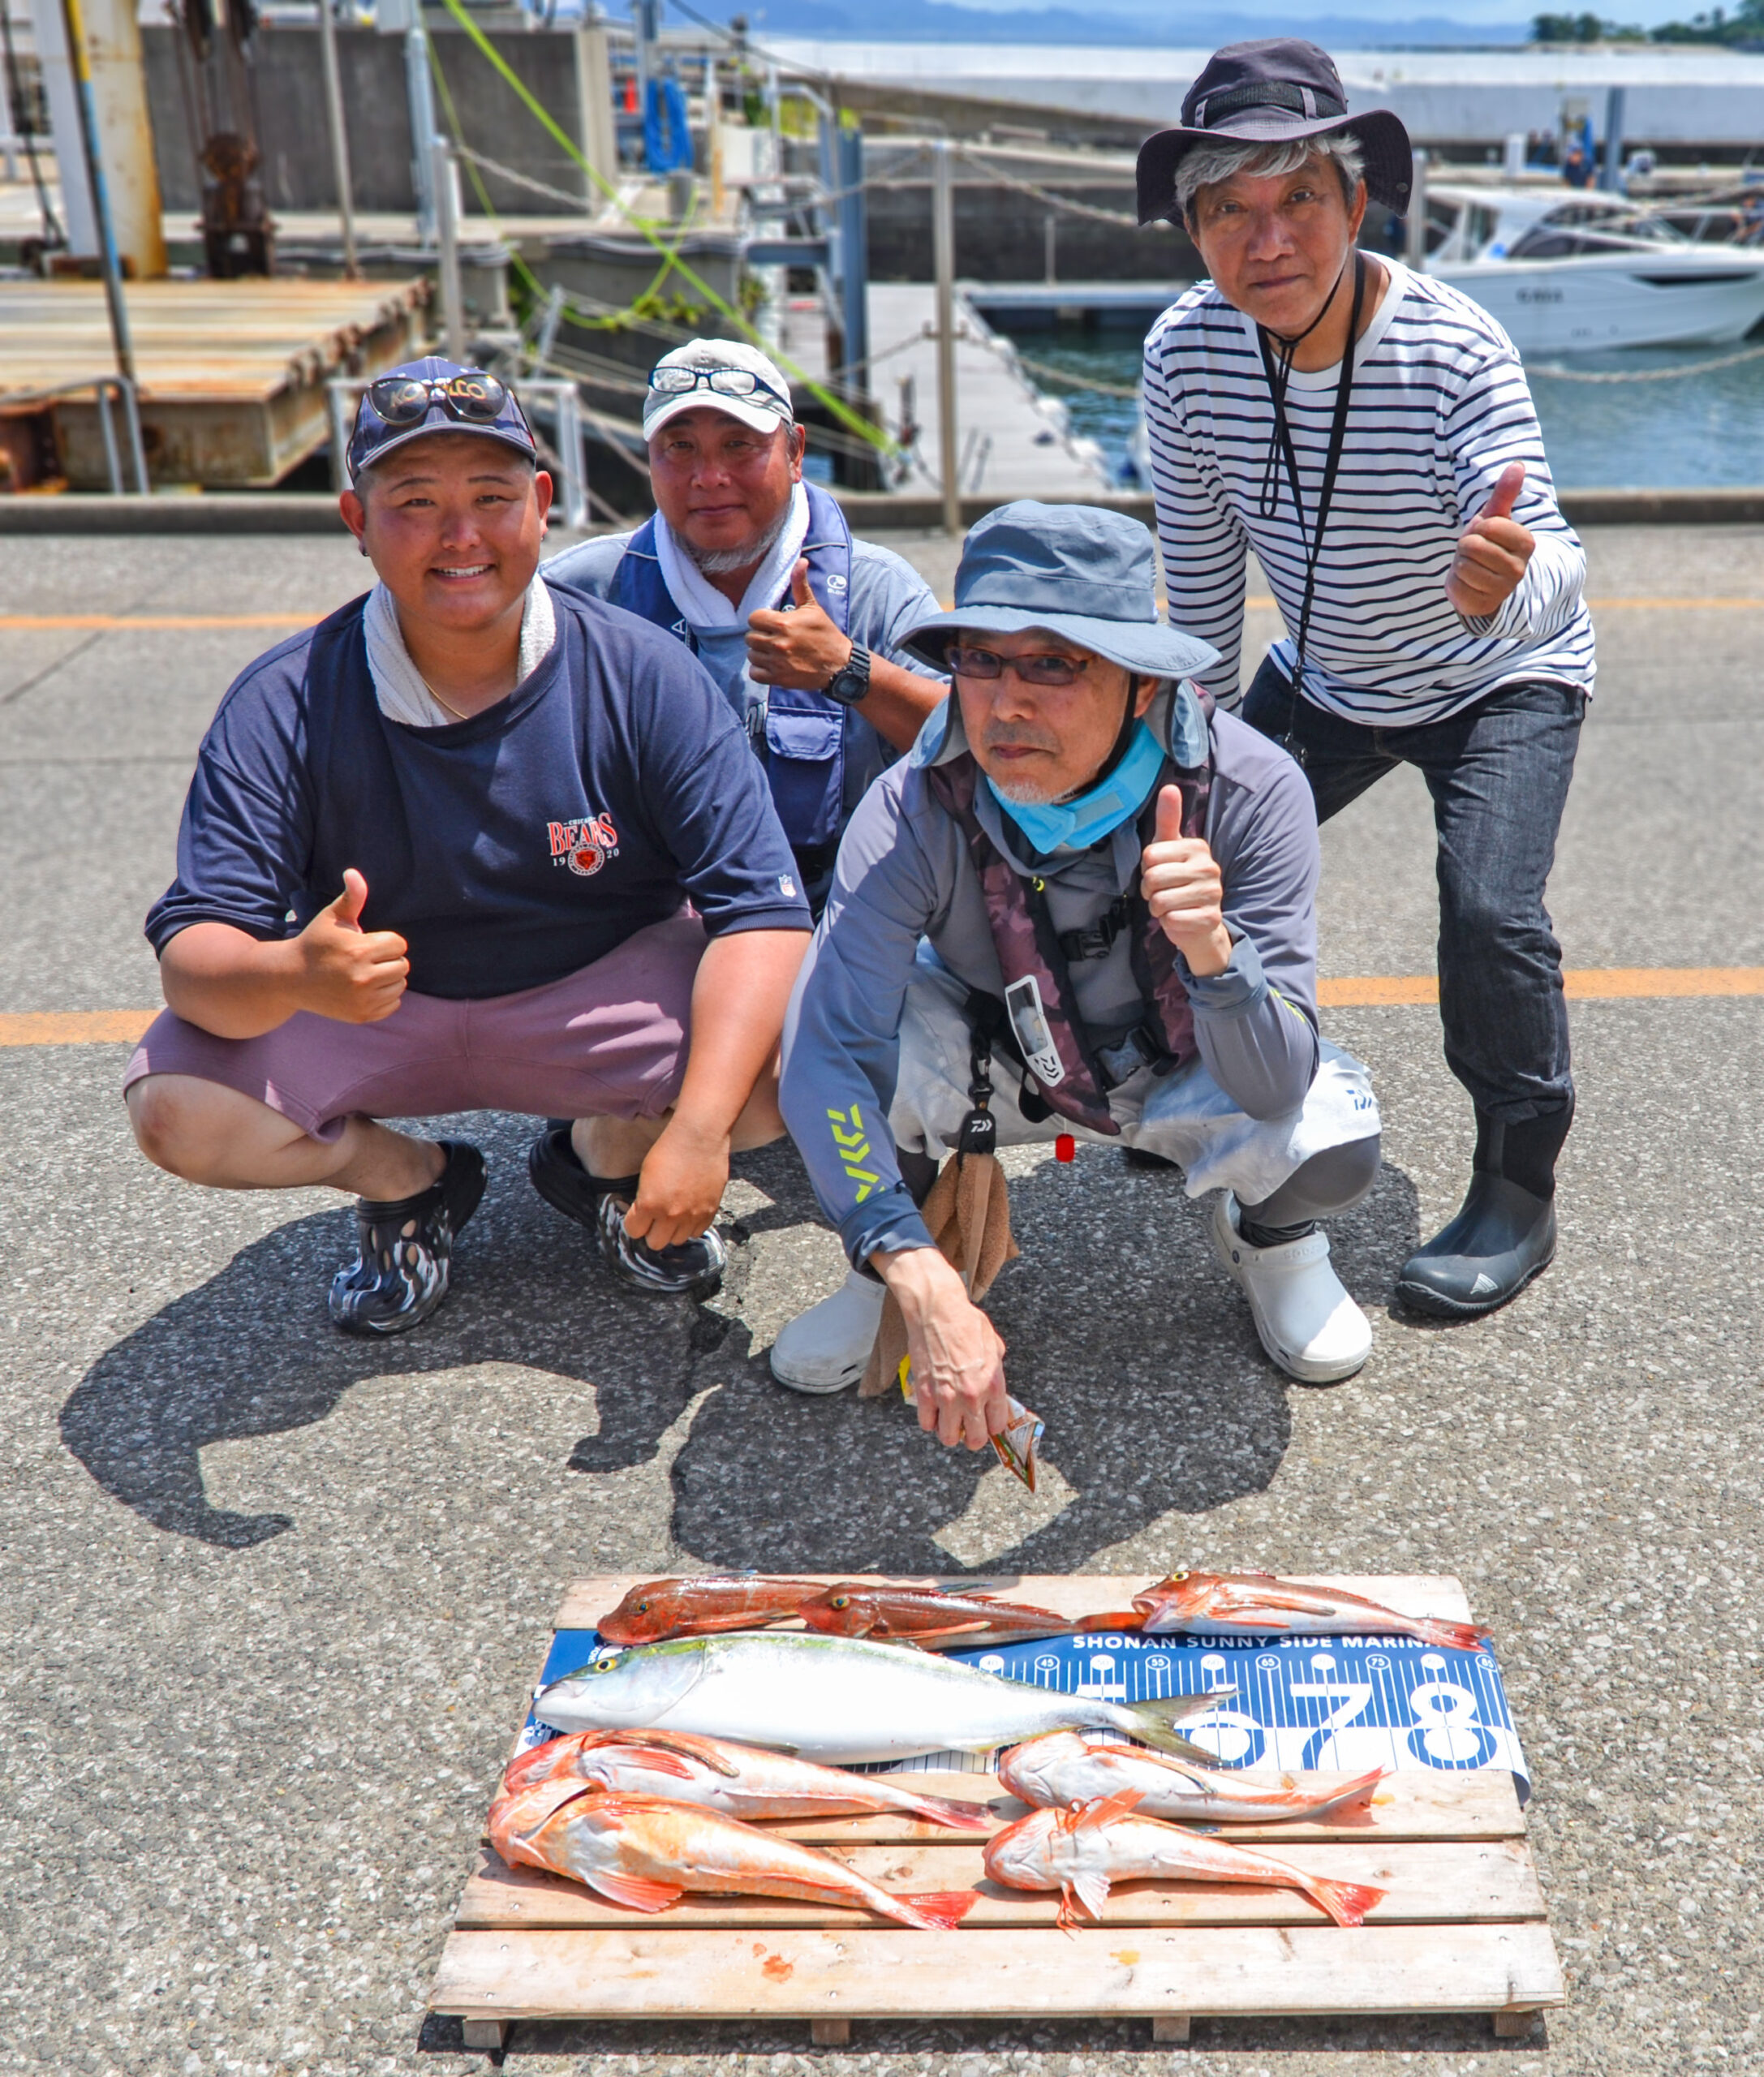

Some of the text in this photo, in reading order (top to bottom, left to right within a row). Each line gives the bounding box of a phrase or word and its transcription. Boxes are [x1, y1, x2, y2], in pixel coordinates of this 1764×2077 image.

[389, 378, 486, 408] KOLCO
[546, 812, 617, 856] BEARS
[553, 848, 619, 866] 19 20
[1073, 1636, 1441, 1649] SHONAN SUNNY SIDE MARIN
[1040, 1658, 1054, 1667] 45
[1151, 1658, 1165, 1666] 55
[1262, 1658, 1275, 1666] 65
[1371, 1658, 1385, 1666] 75
[1289, 1683, 1372, 1771] 7
[1407, 1682, 1498, 1770] 8
